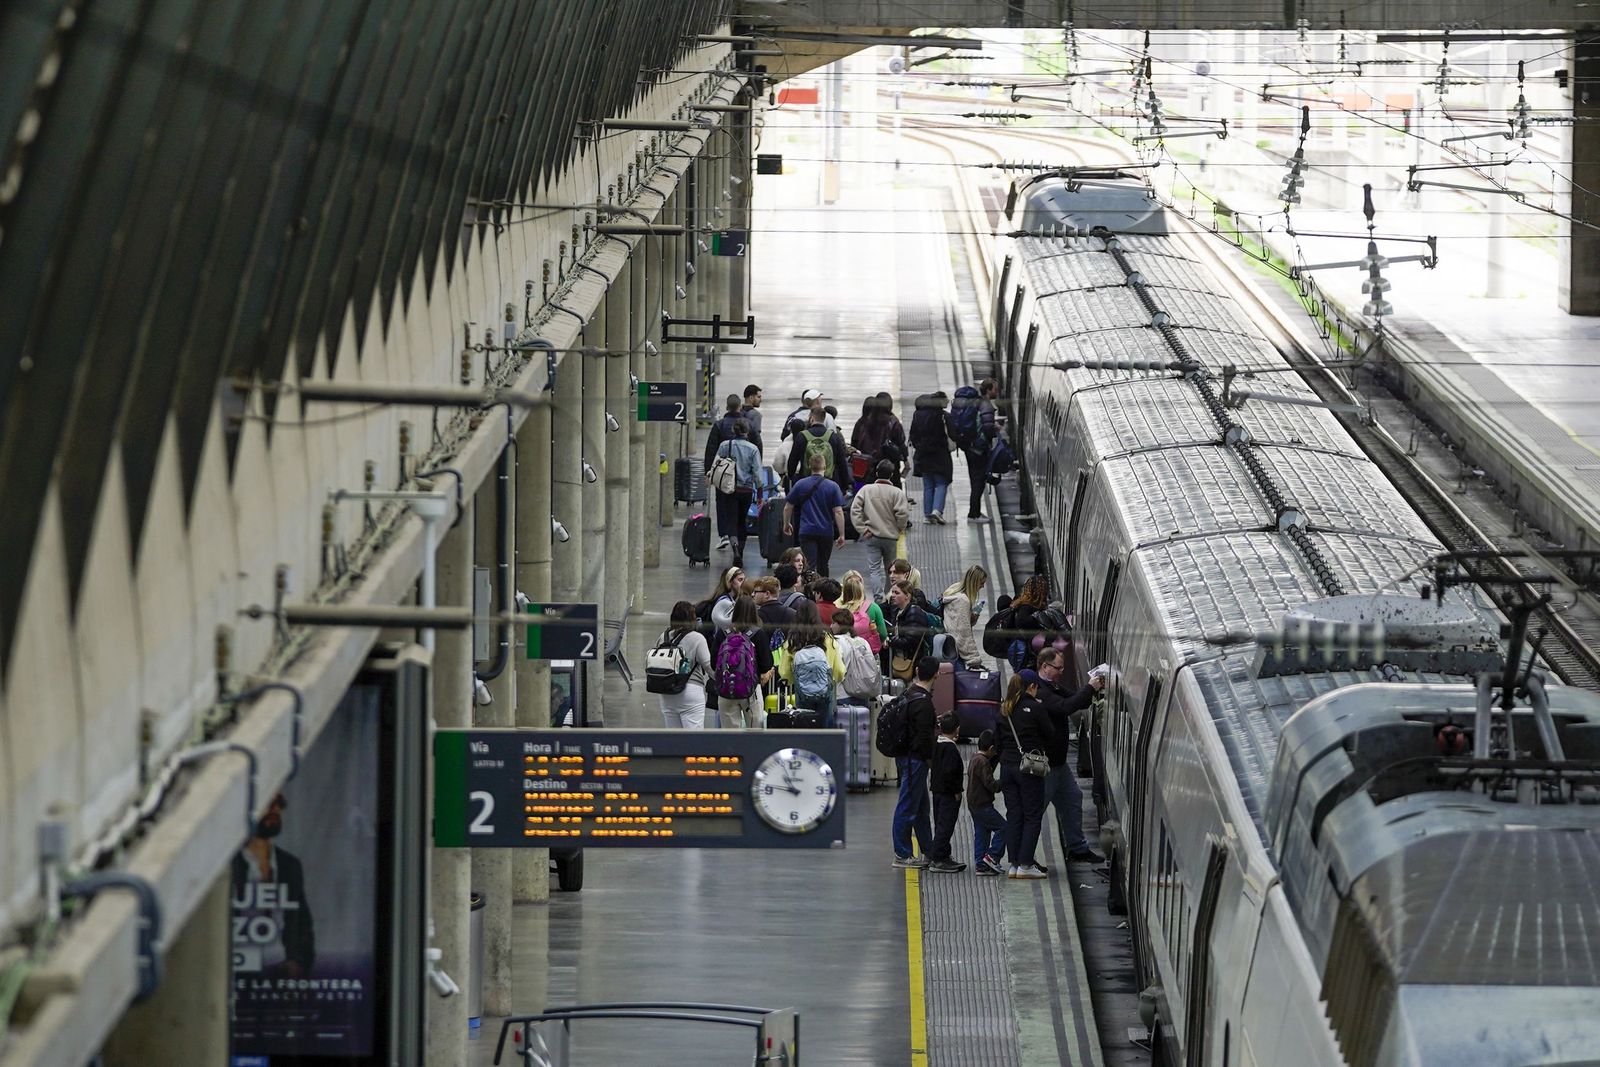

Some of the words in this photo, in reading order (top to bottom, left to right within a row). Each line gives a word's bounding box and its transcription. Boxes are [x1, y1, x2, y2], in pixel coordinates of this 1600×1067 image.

[737, 243, 745, 256] 2
[674, 402, 685, 420] 2
[580, 632, 594, 657] 2
[470, 741, 489, 753] Vía
[524, 742, 552, 753] Hora
[593, 743, 619, 753] Tren
[788, 760, 802, 770] 12
[524, 779, 567, 789] Destino
[765, 786, 773, 796] 9
[816, 786, 824, 795] 3
[470, 791, 494, 834] 2
[790, 811, 798, 821] 6
[252, 979, 271, 989] LA
[278, 979, 362, 989] FRONTERA
